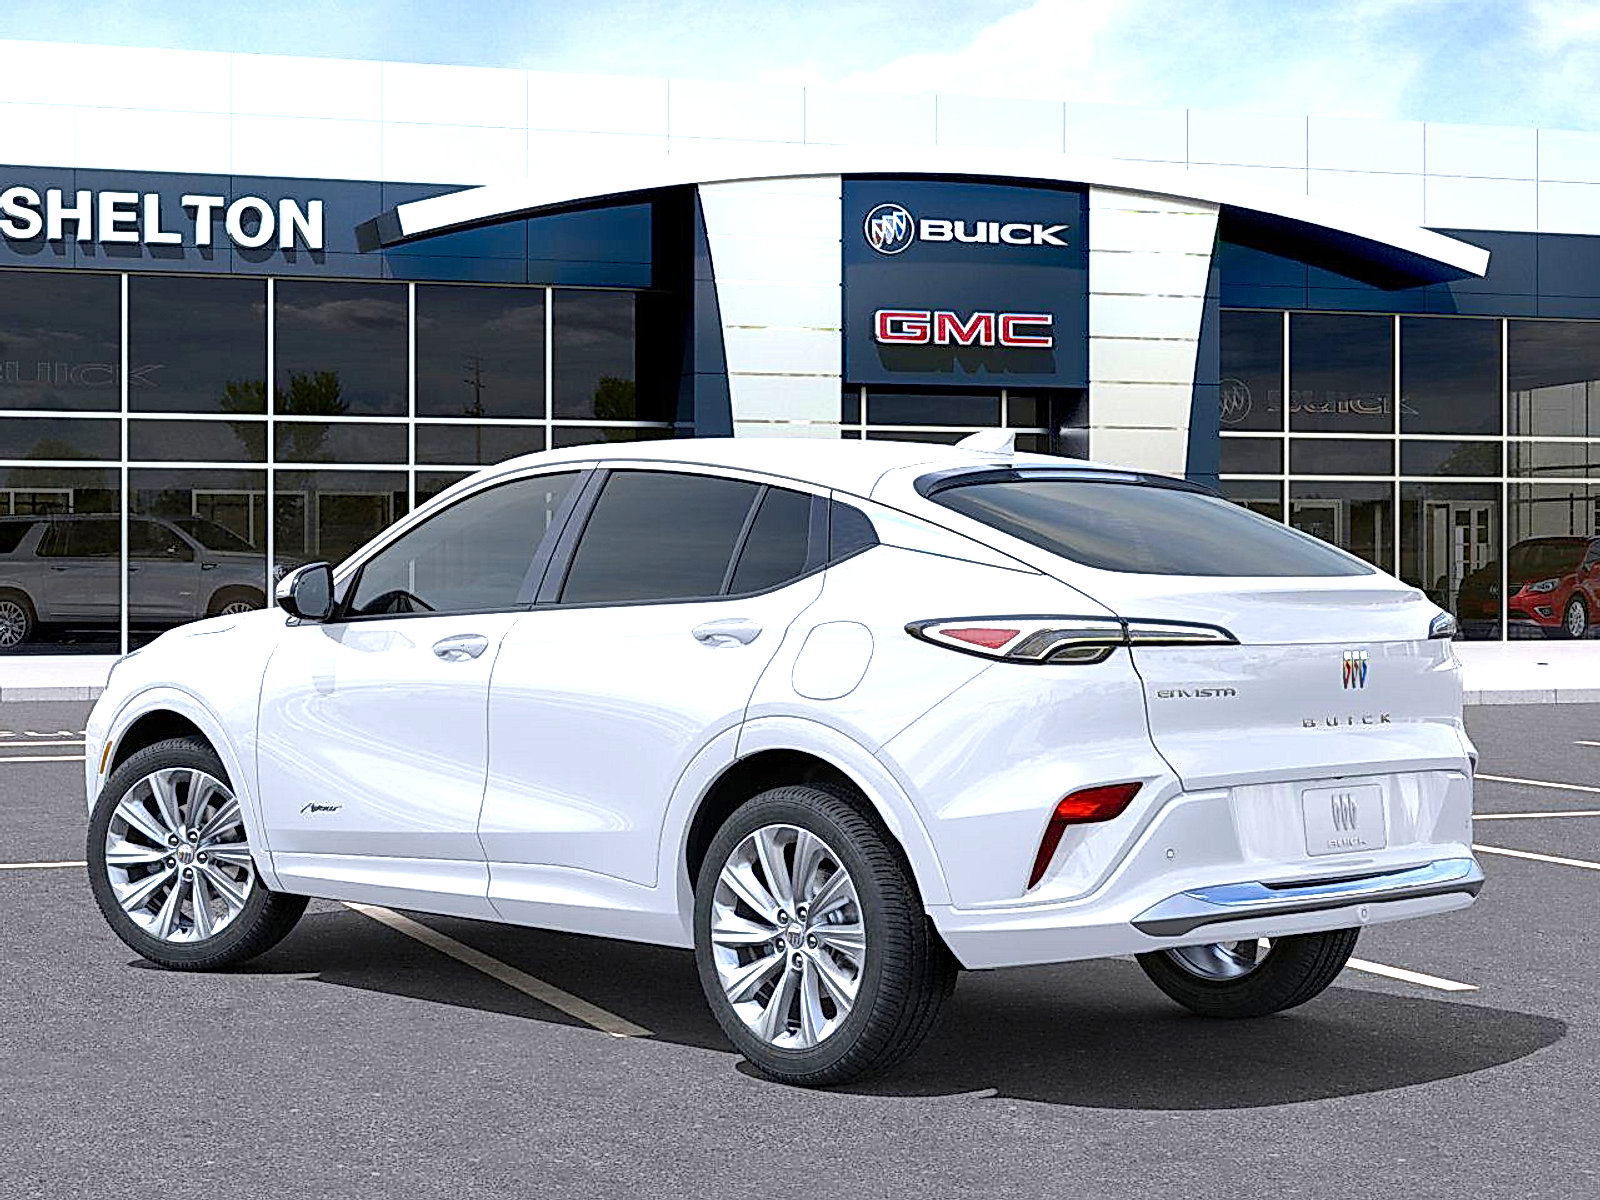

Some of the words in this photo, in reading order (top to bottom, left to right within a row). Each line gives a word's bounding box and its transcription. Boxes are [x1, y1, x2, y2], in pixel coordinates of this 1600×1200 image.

[0, 186, 323, 249] SHELTON
[919, 219, 1070, 247] BUICK
[875, 309, 1053, 348] GMC
[1157, 687, 1237, 699] ENVISTA
[1302, 713, 1391, 728] BUICK
